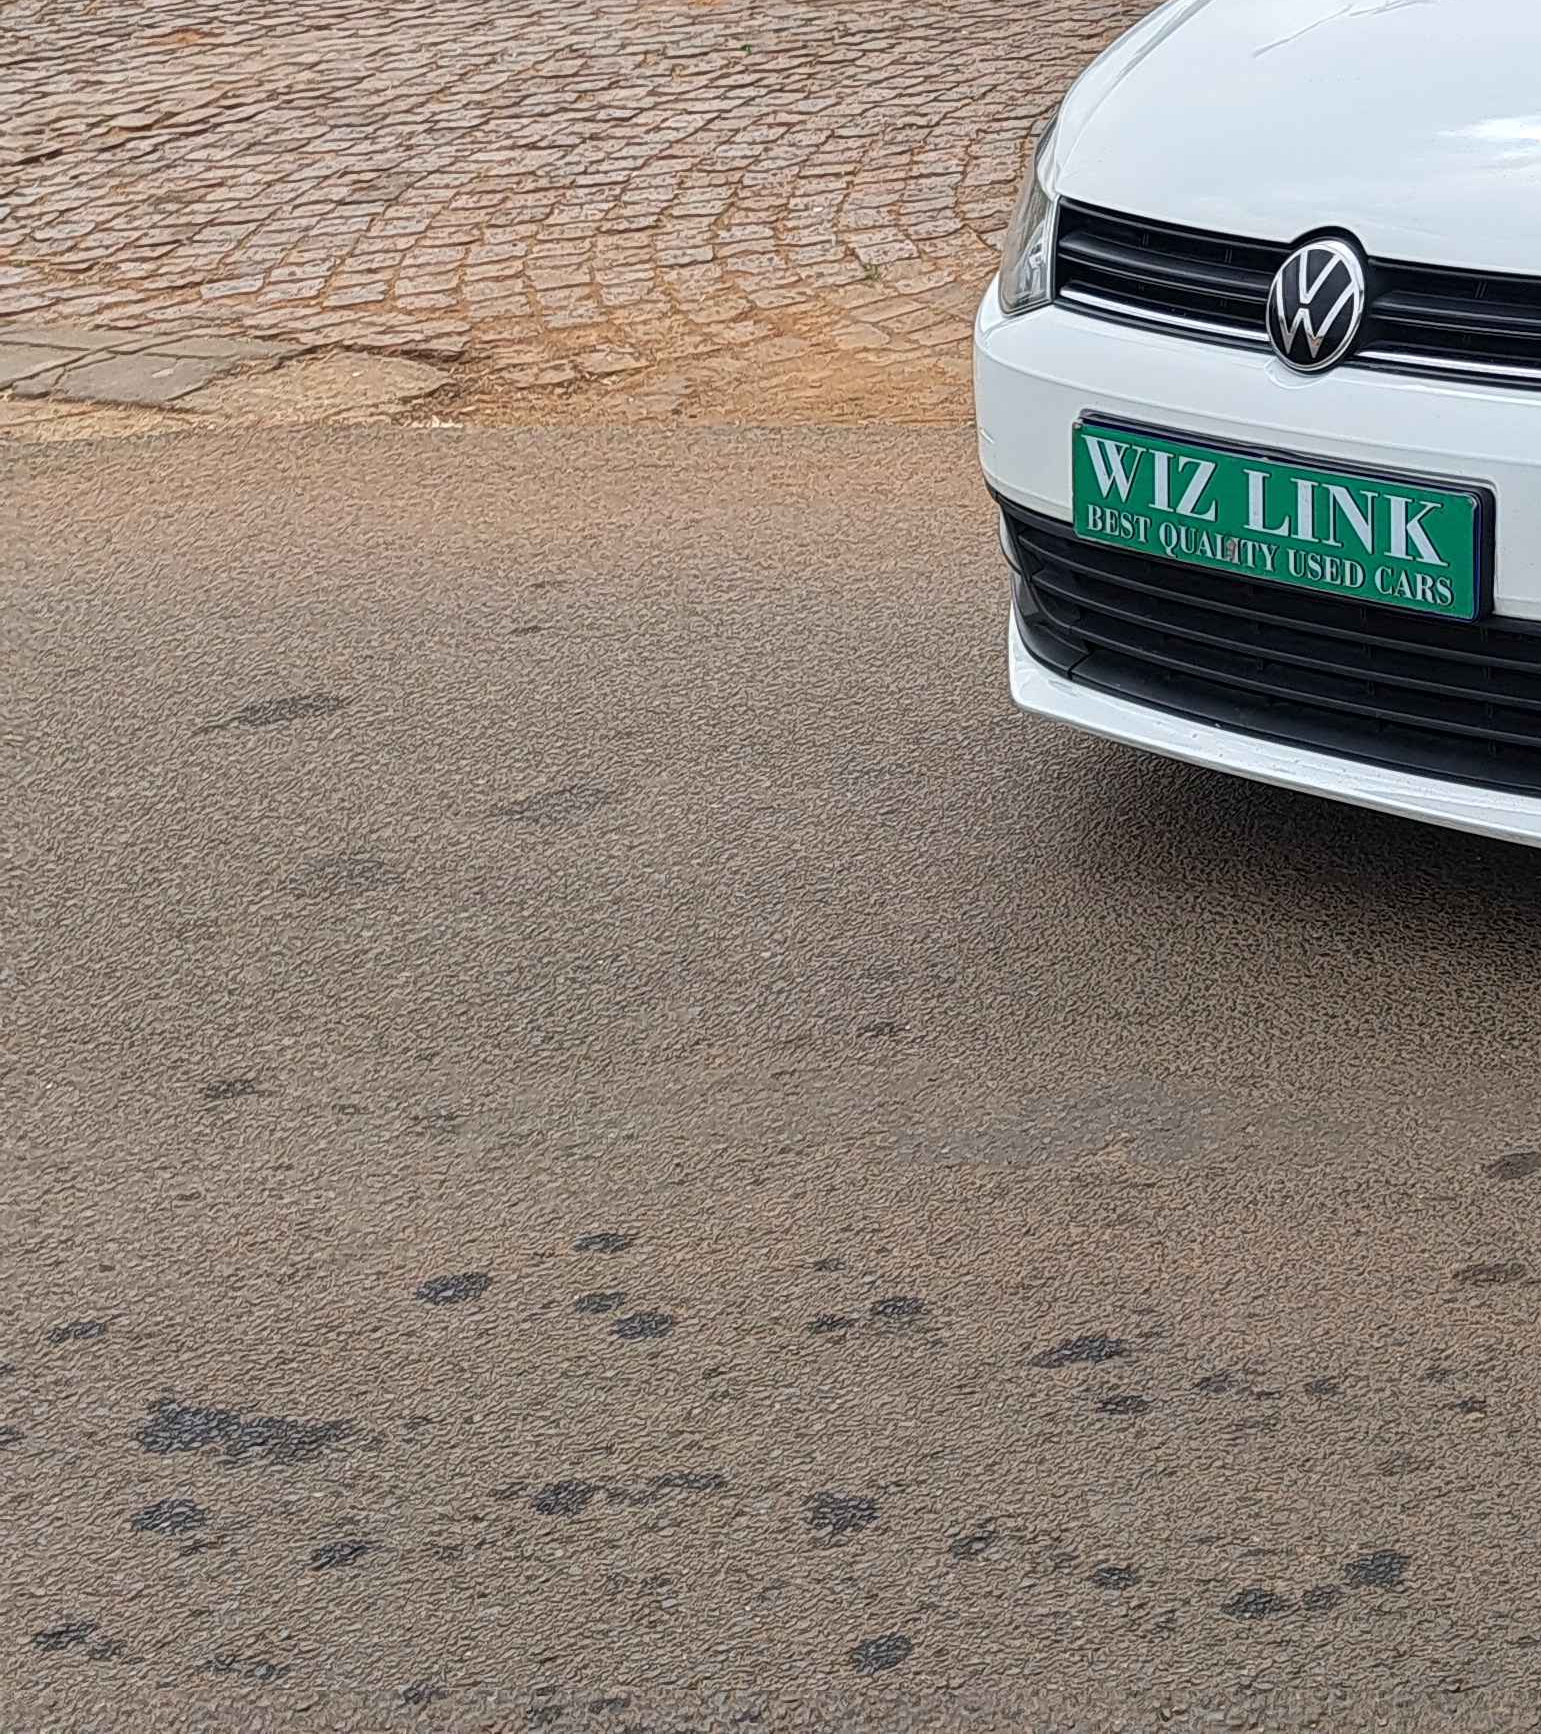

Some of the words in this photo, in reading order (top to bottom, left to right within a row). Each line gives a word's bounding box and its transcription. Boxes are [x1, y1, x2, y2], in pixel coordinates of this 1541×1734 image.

[1081, 433, 1219, 523] WIZ
[1242, 467, 1450, 568] LINK
[1087, 503, 1152, 543] BEST
[1157, 522, 1281, 574] QUALITY
[1286, 548, 1366, 590] USED
[1375, 565, 1455, 608] CARS
